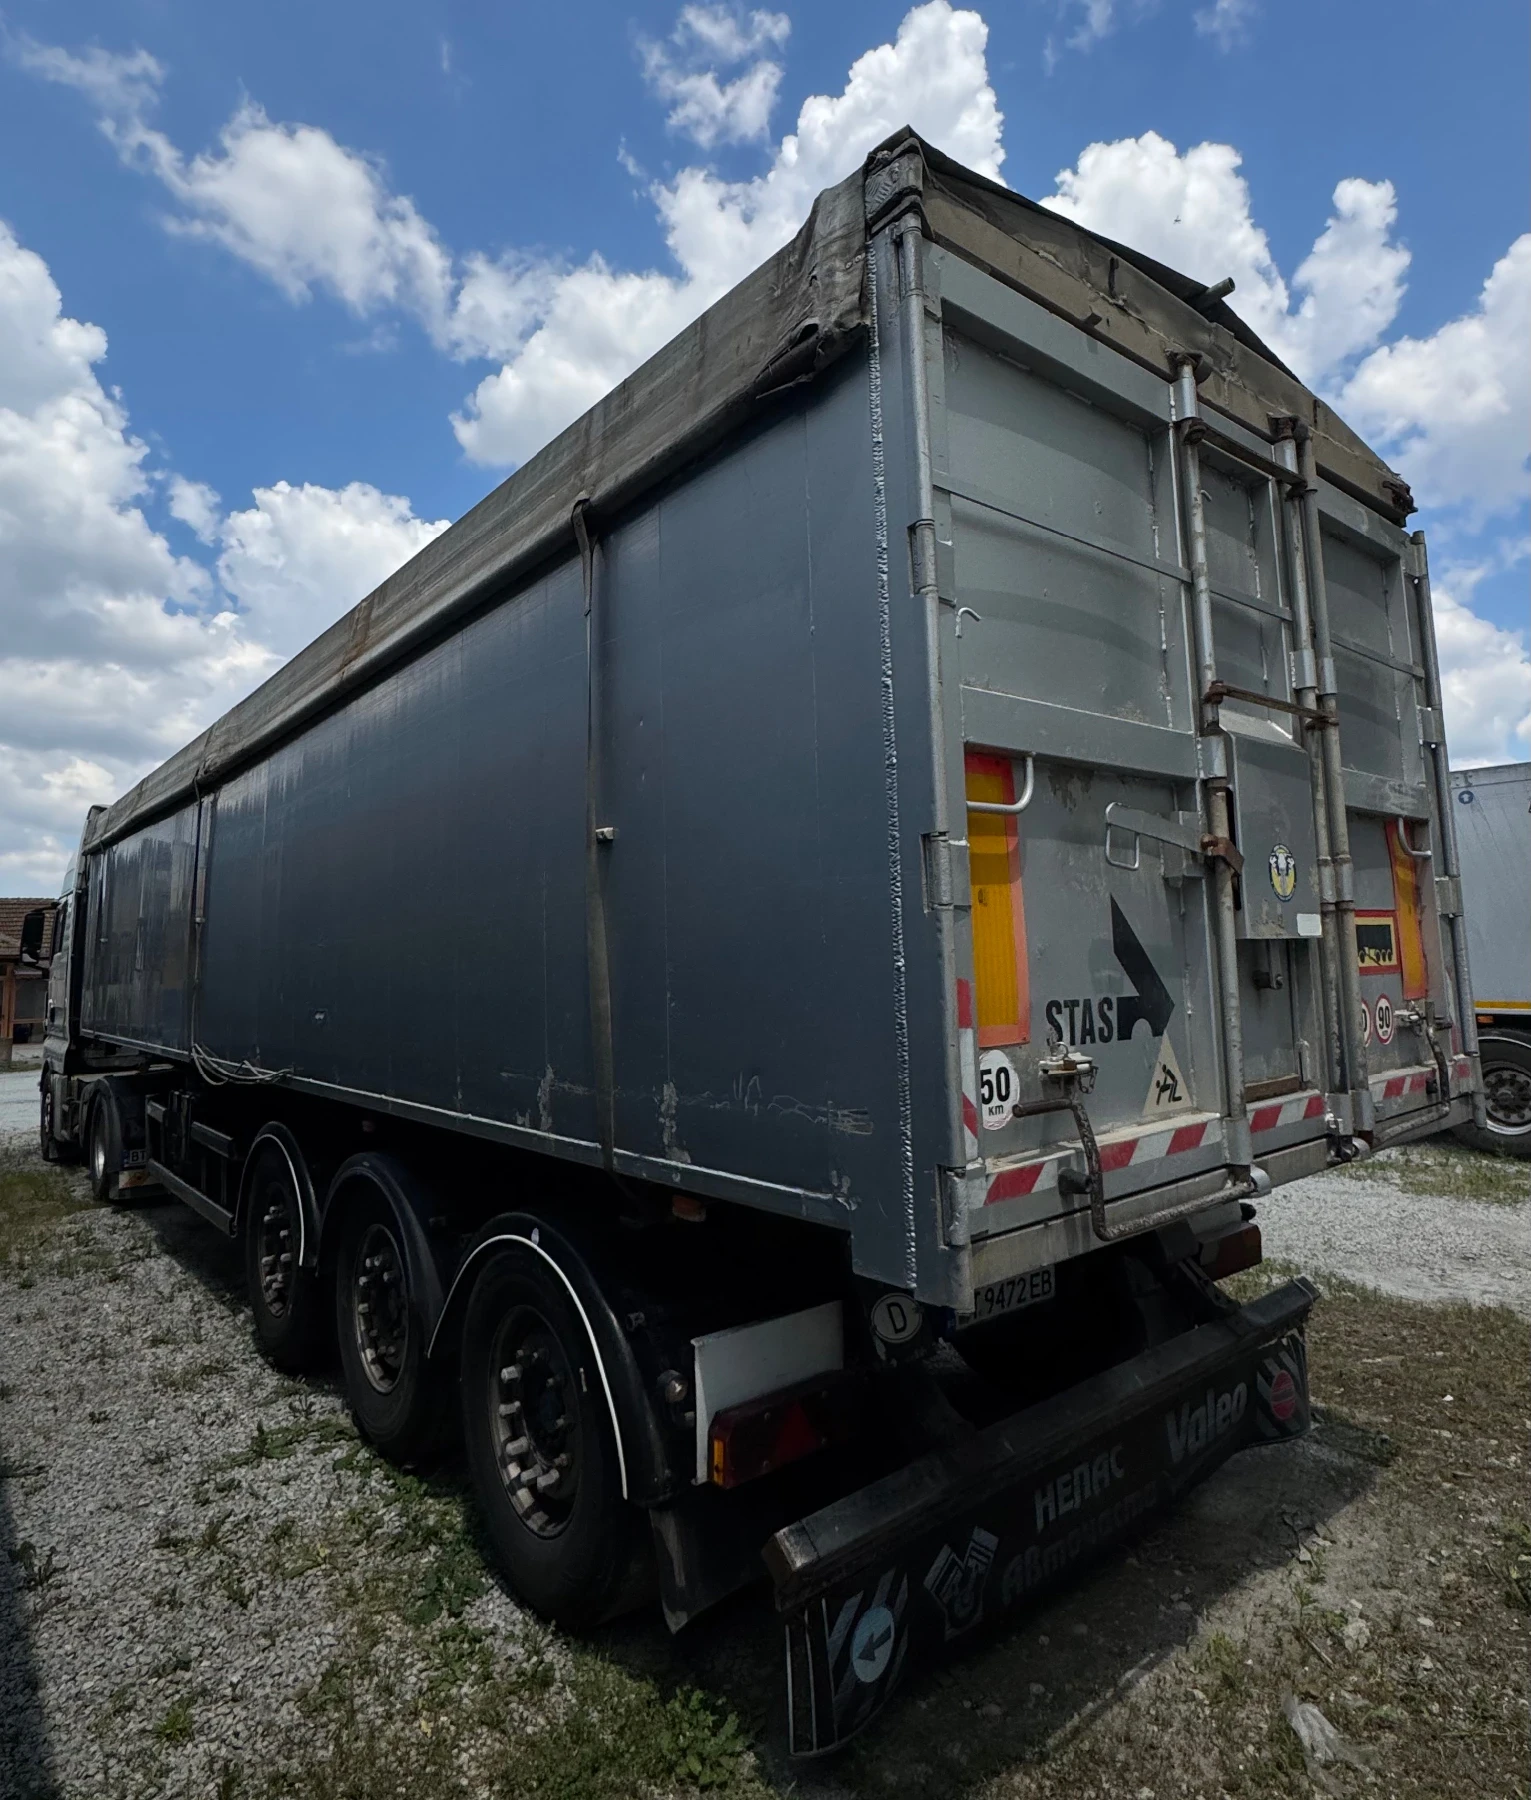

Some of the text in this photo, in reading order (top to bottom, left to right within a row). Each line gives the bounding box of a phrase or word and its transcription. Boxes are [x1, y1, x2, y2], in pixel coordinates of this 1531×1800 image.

[1046, 997, 1113, 1046] STAS
[1378, 1005, 1390, 1029] 90
[980, 1066, 1011, 1105] 50
[886, 1302, 907, 1334] D
[1165, 1382, 1248, 1464] Valeo
